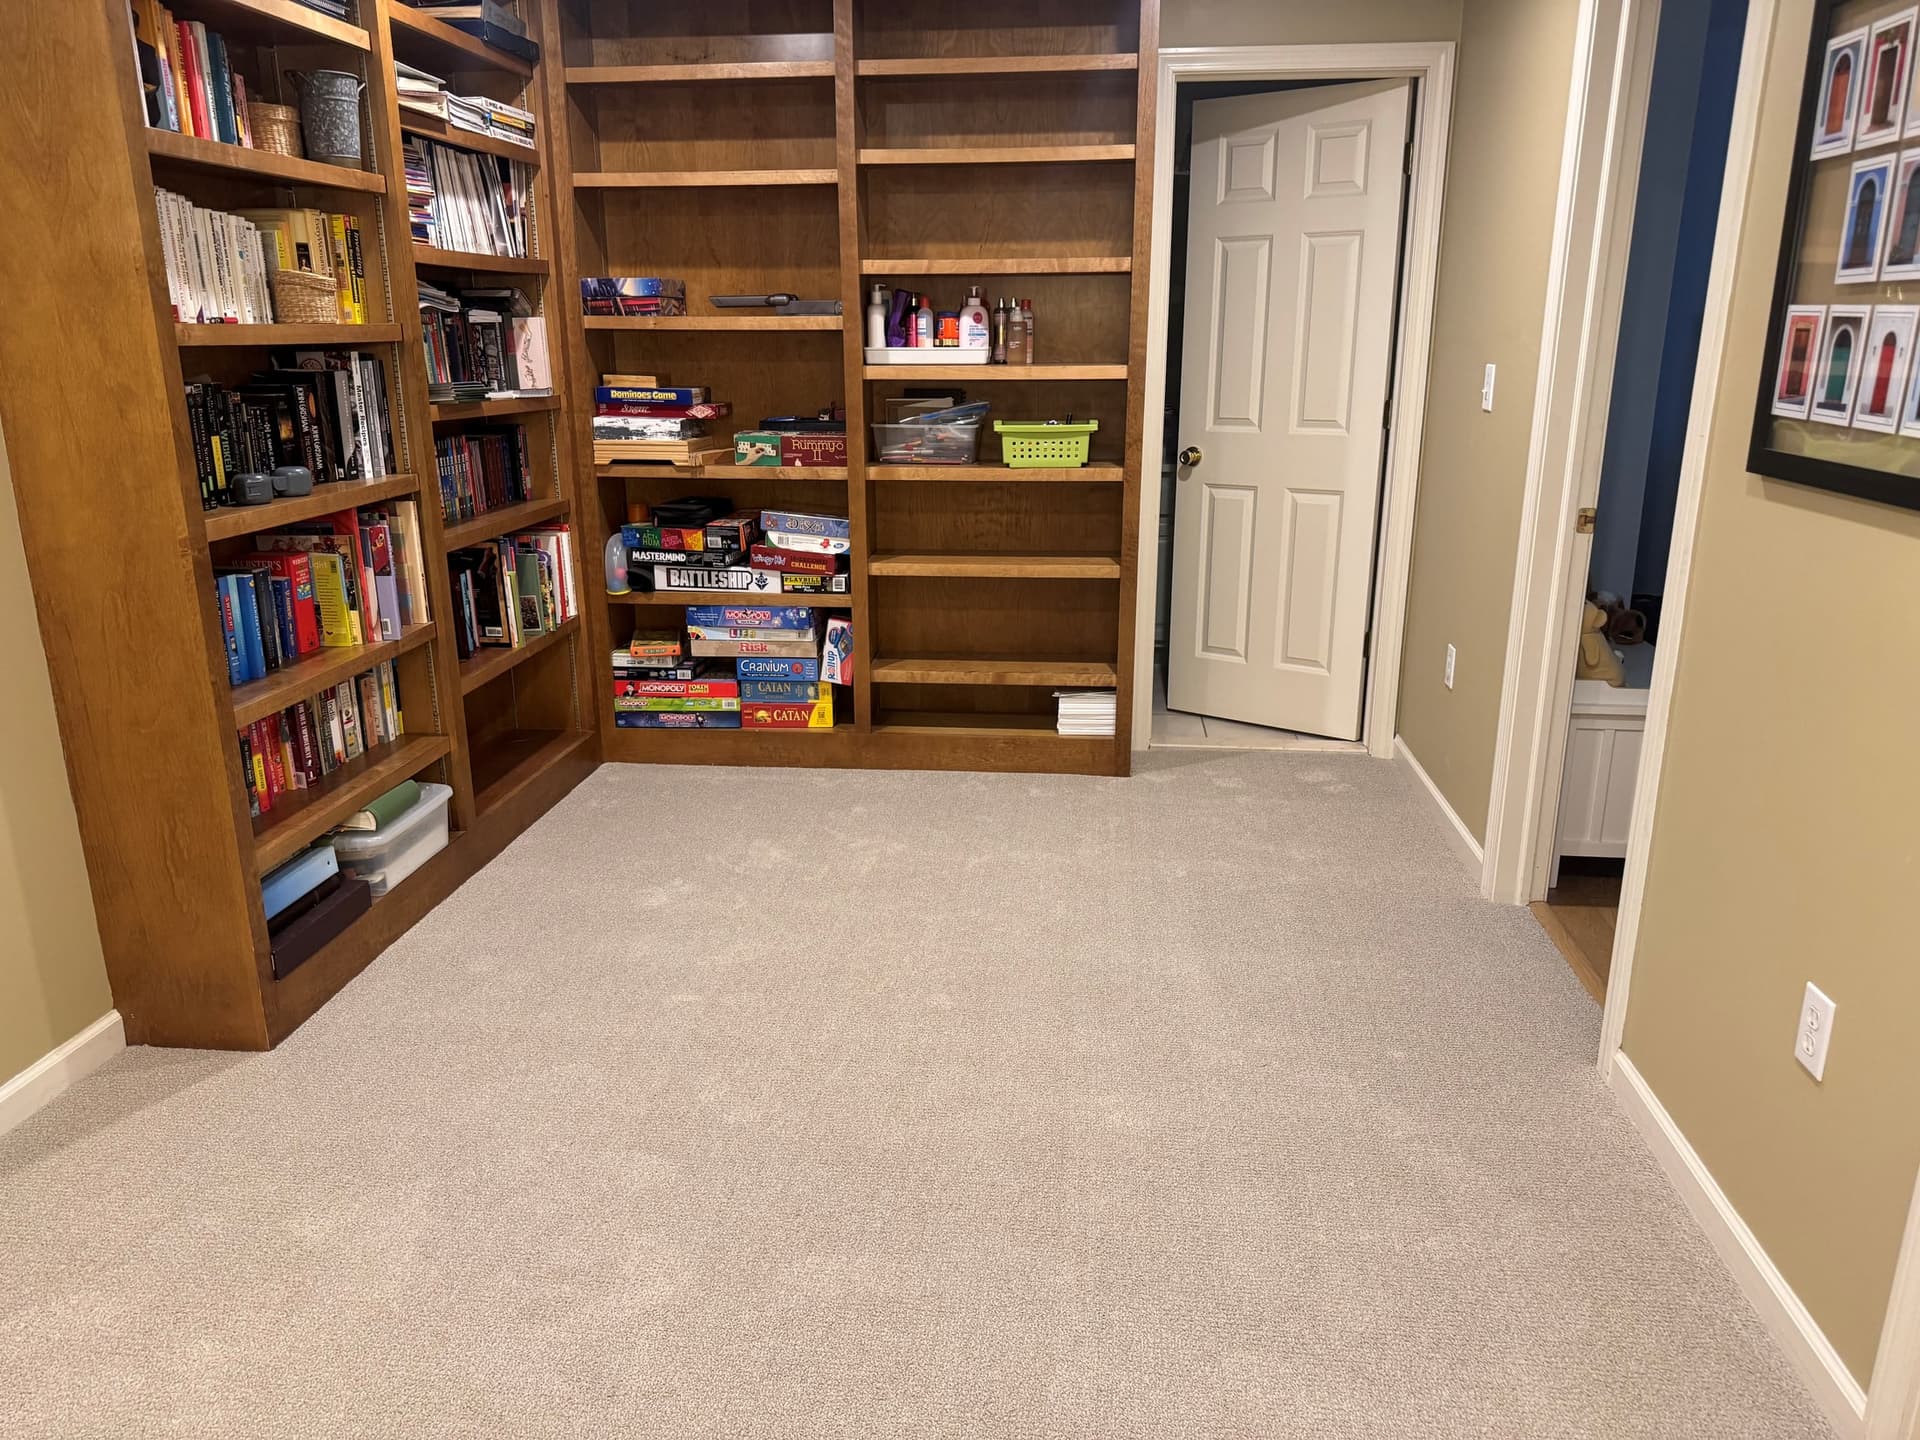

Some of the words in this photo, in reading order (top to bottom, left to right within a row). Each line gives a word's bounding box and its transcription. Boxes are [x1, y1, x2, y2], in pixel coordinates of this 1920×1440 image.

[352, 231, 364, 276] Investing
[296, 386, 305, 405] JOHN
[610, 390, 652, 400] Dominoes
[652, 391, 677, 401] Game
[299, 405, 310, 433] GRISHAM
[356, 384, 364, 413] Master
[360, 415, 368, 446] Recipes
[220, 430, 233, 472] WICKED
[632, 551, 686, 562] MASTERMIND
[790, 561, 827, 571] CHALLENGE
[669, 569, 752, 590] BATTLESHIP
[224, 597, 233, 628] SWITCH
[725, 609, 772, 620] MONOPOLY
[739, 642, 768, 652] Risk
[640, 684, 686, 693] MONOPOLY
[758, 681, 791, 693] CATAN
[773, 709, 809, 721] CATAN
